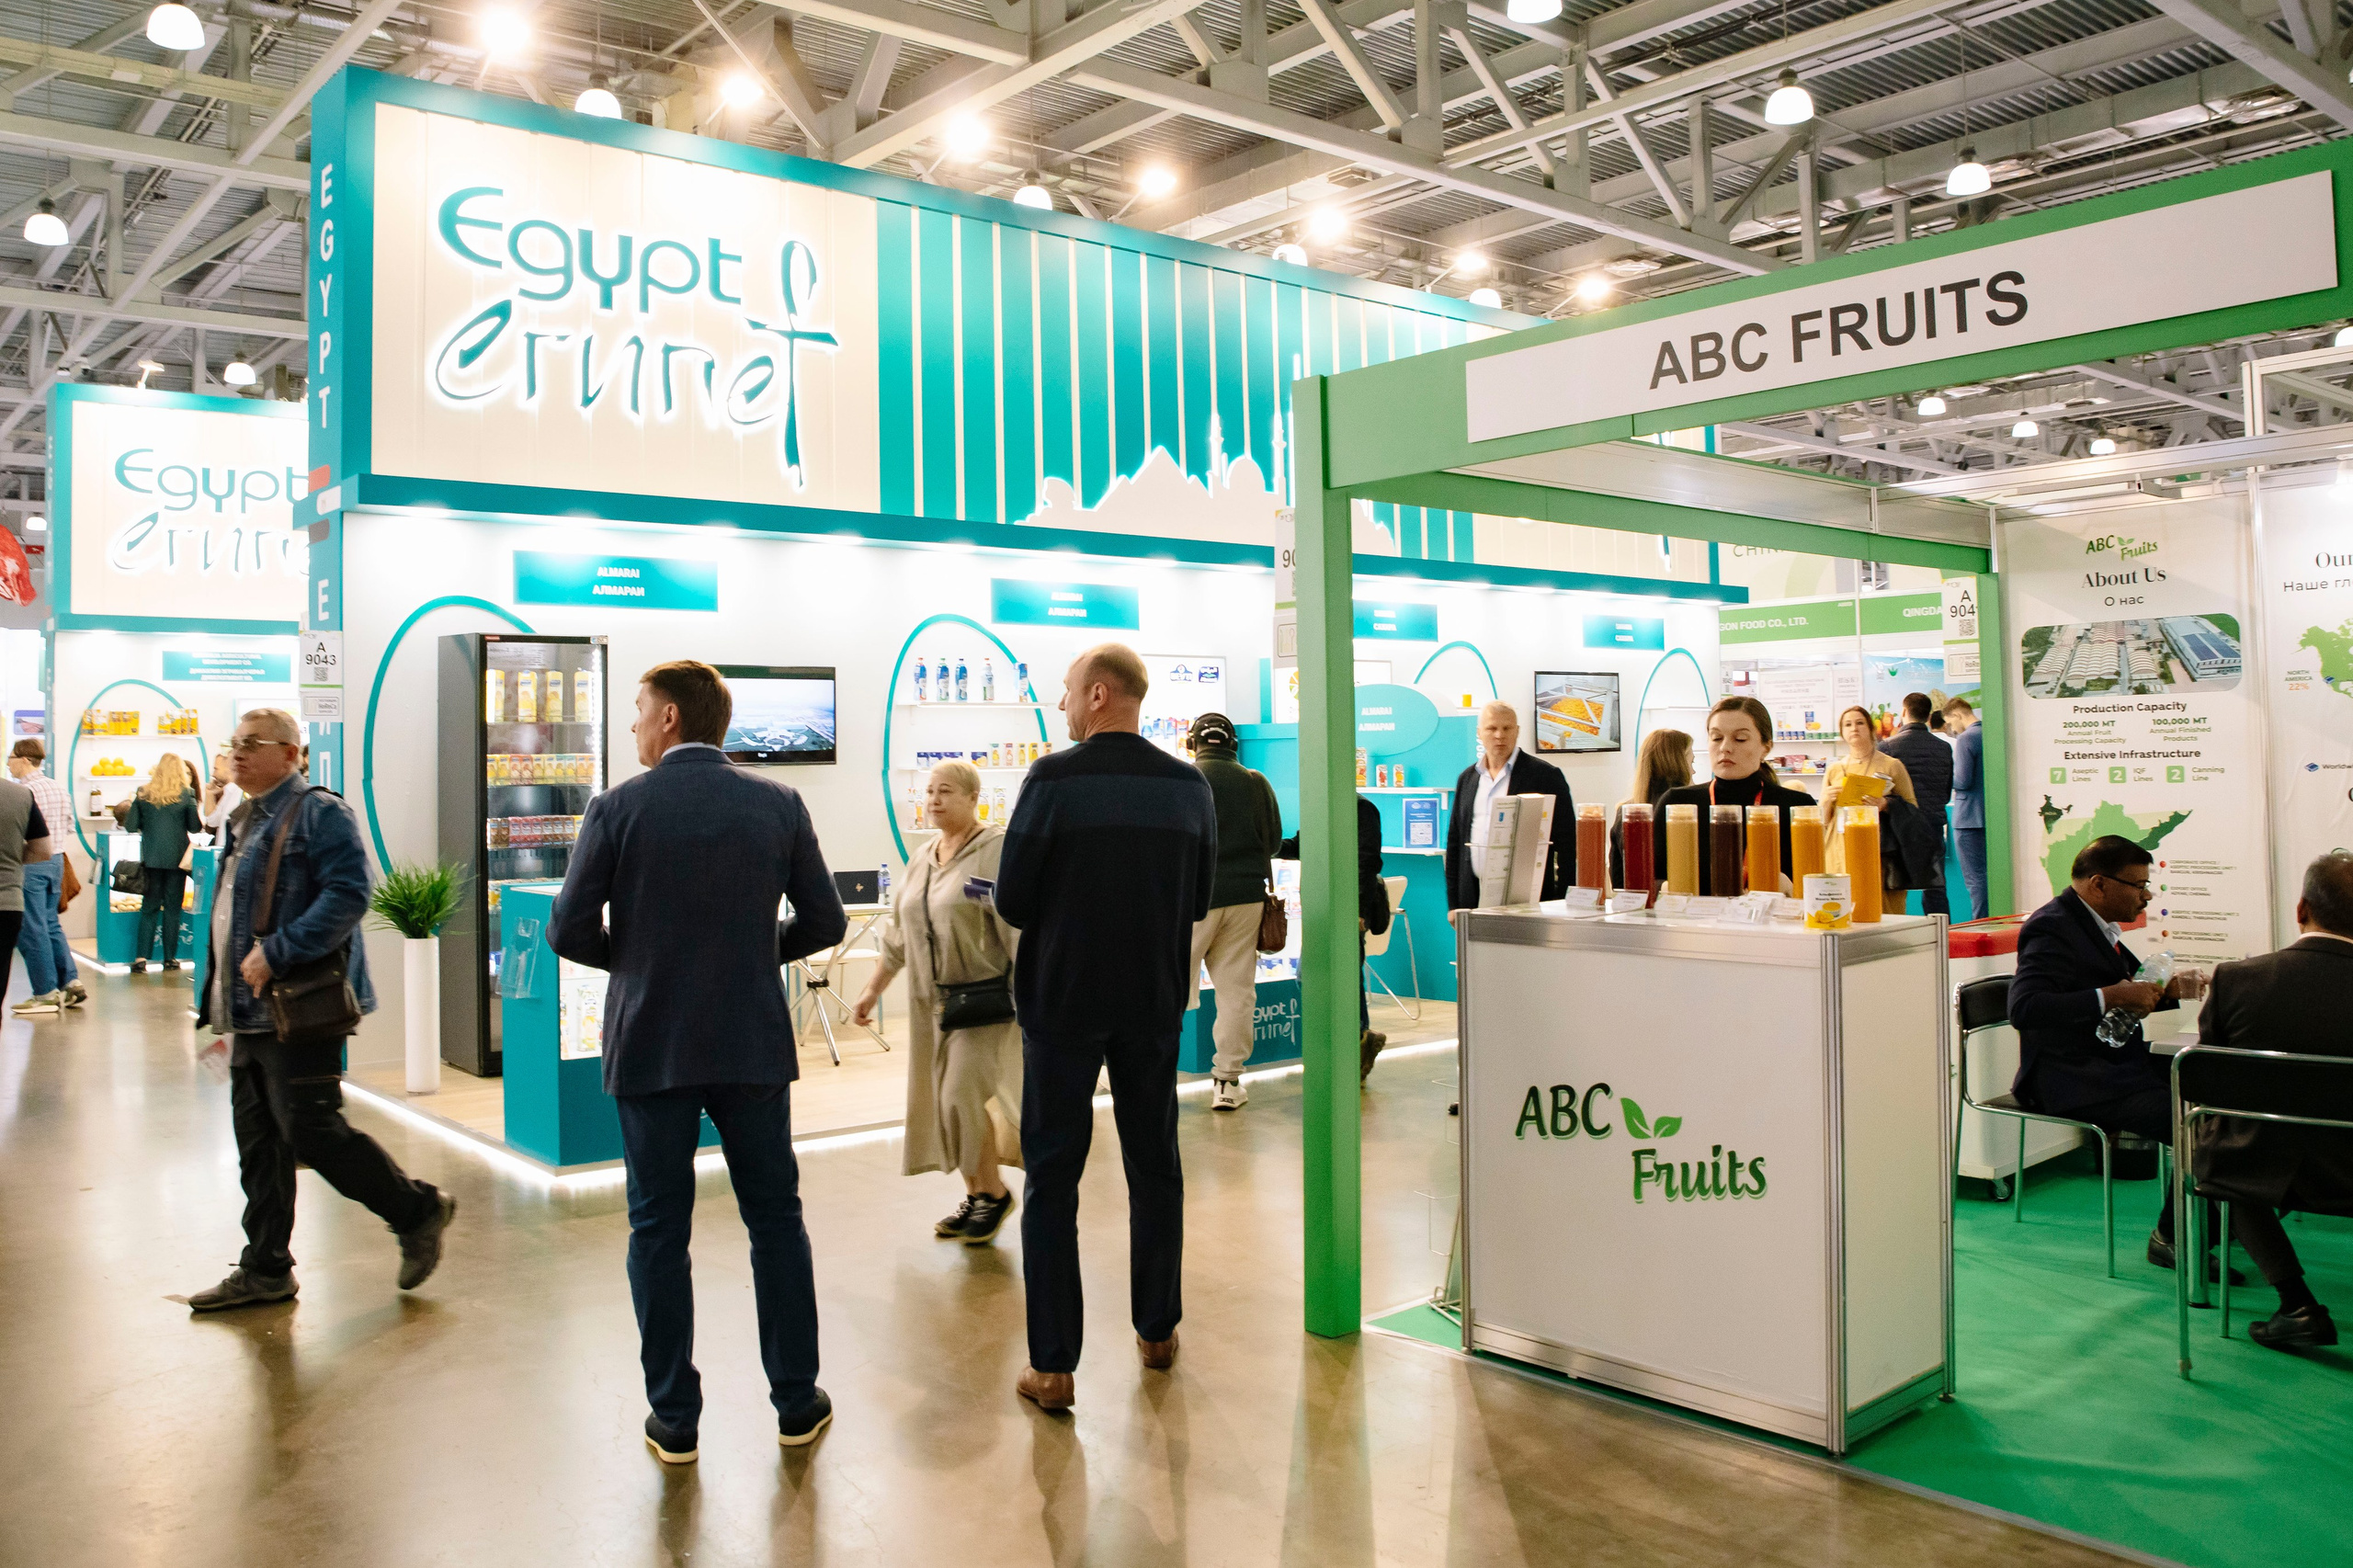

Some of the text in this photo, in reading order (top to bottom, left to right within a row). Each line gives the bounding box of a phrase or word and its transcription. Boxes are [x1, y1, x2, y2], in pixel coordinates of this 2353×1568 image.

[438, 187, 743, 313] Egypt
[318, 163, 335, 429] EGYPT
[1648, 269, 2029, 391] ABC FRUITS
[114, 449, 310, 515] Egypt
[112, 511, 311, 576] Егип
[2086, 535, 2115, 554] ABC
[2120, 541, 2158, 562] Fruits
[597, 566, 641, 578] ALMARAI
[2081, 566, 2166, 588] About Us
[2284, 578, 2353, 592] Наше гл
[1961, 589, 1972, 603] A
[2120, 596, 2144, 606] нас
[1949, 604, 1978, 618] 904
[1740, 619, 1766, 630] FOOD
[1788, 616, 1810, 626] LTD.
[316, 642, 326, 653] A
[305, 653, 336, 665] 9043
[2288, 683, 2310, 691] 22%
[2073, 701, 2188, 714] Production Capacity
[2063, 720, 2116, 729] 200,000 MT
[2152, 717, 2190, 726] 100,000
[2064, 749, 2201, 760] Extensive Infrastructure
[1253, 1002, 1287, 1023] gypt
[1254, 998, 1302, 1046] гипет
[1515, 1082, 1613, 1141] ABC
[1631, 1144, 1768, 1204] Fruits
